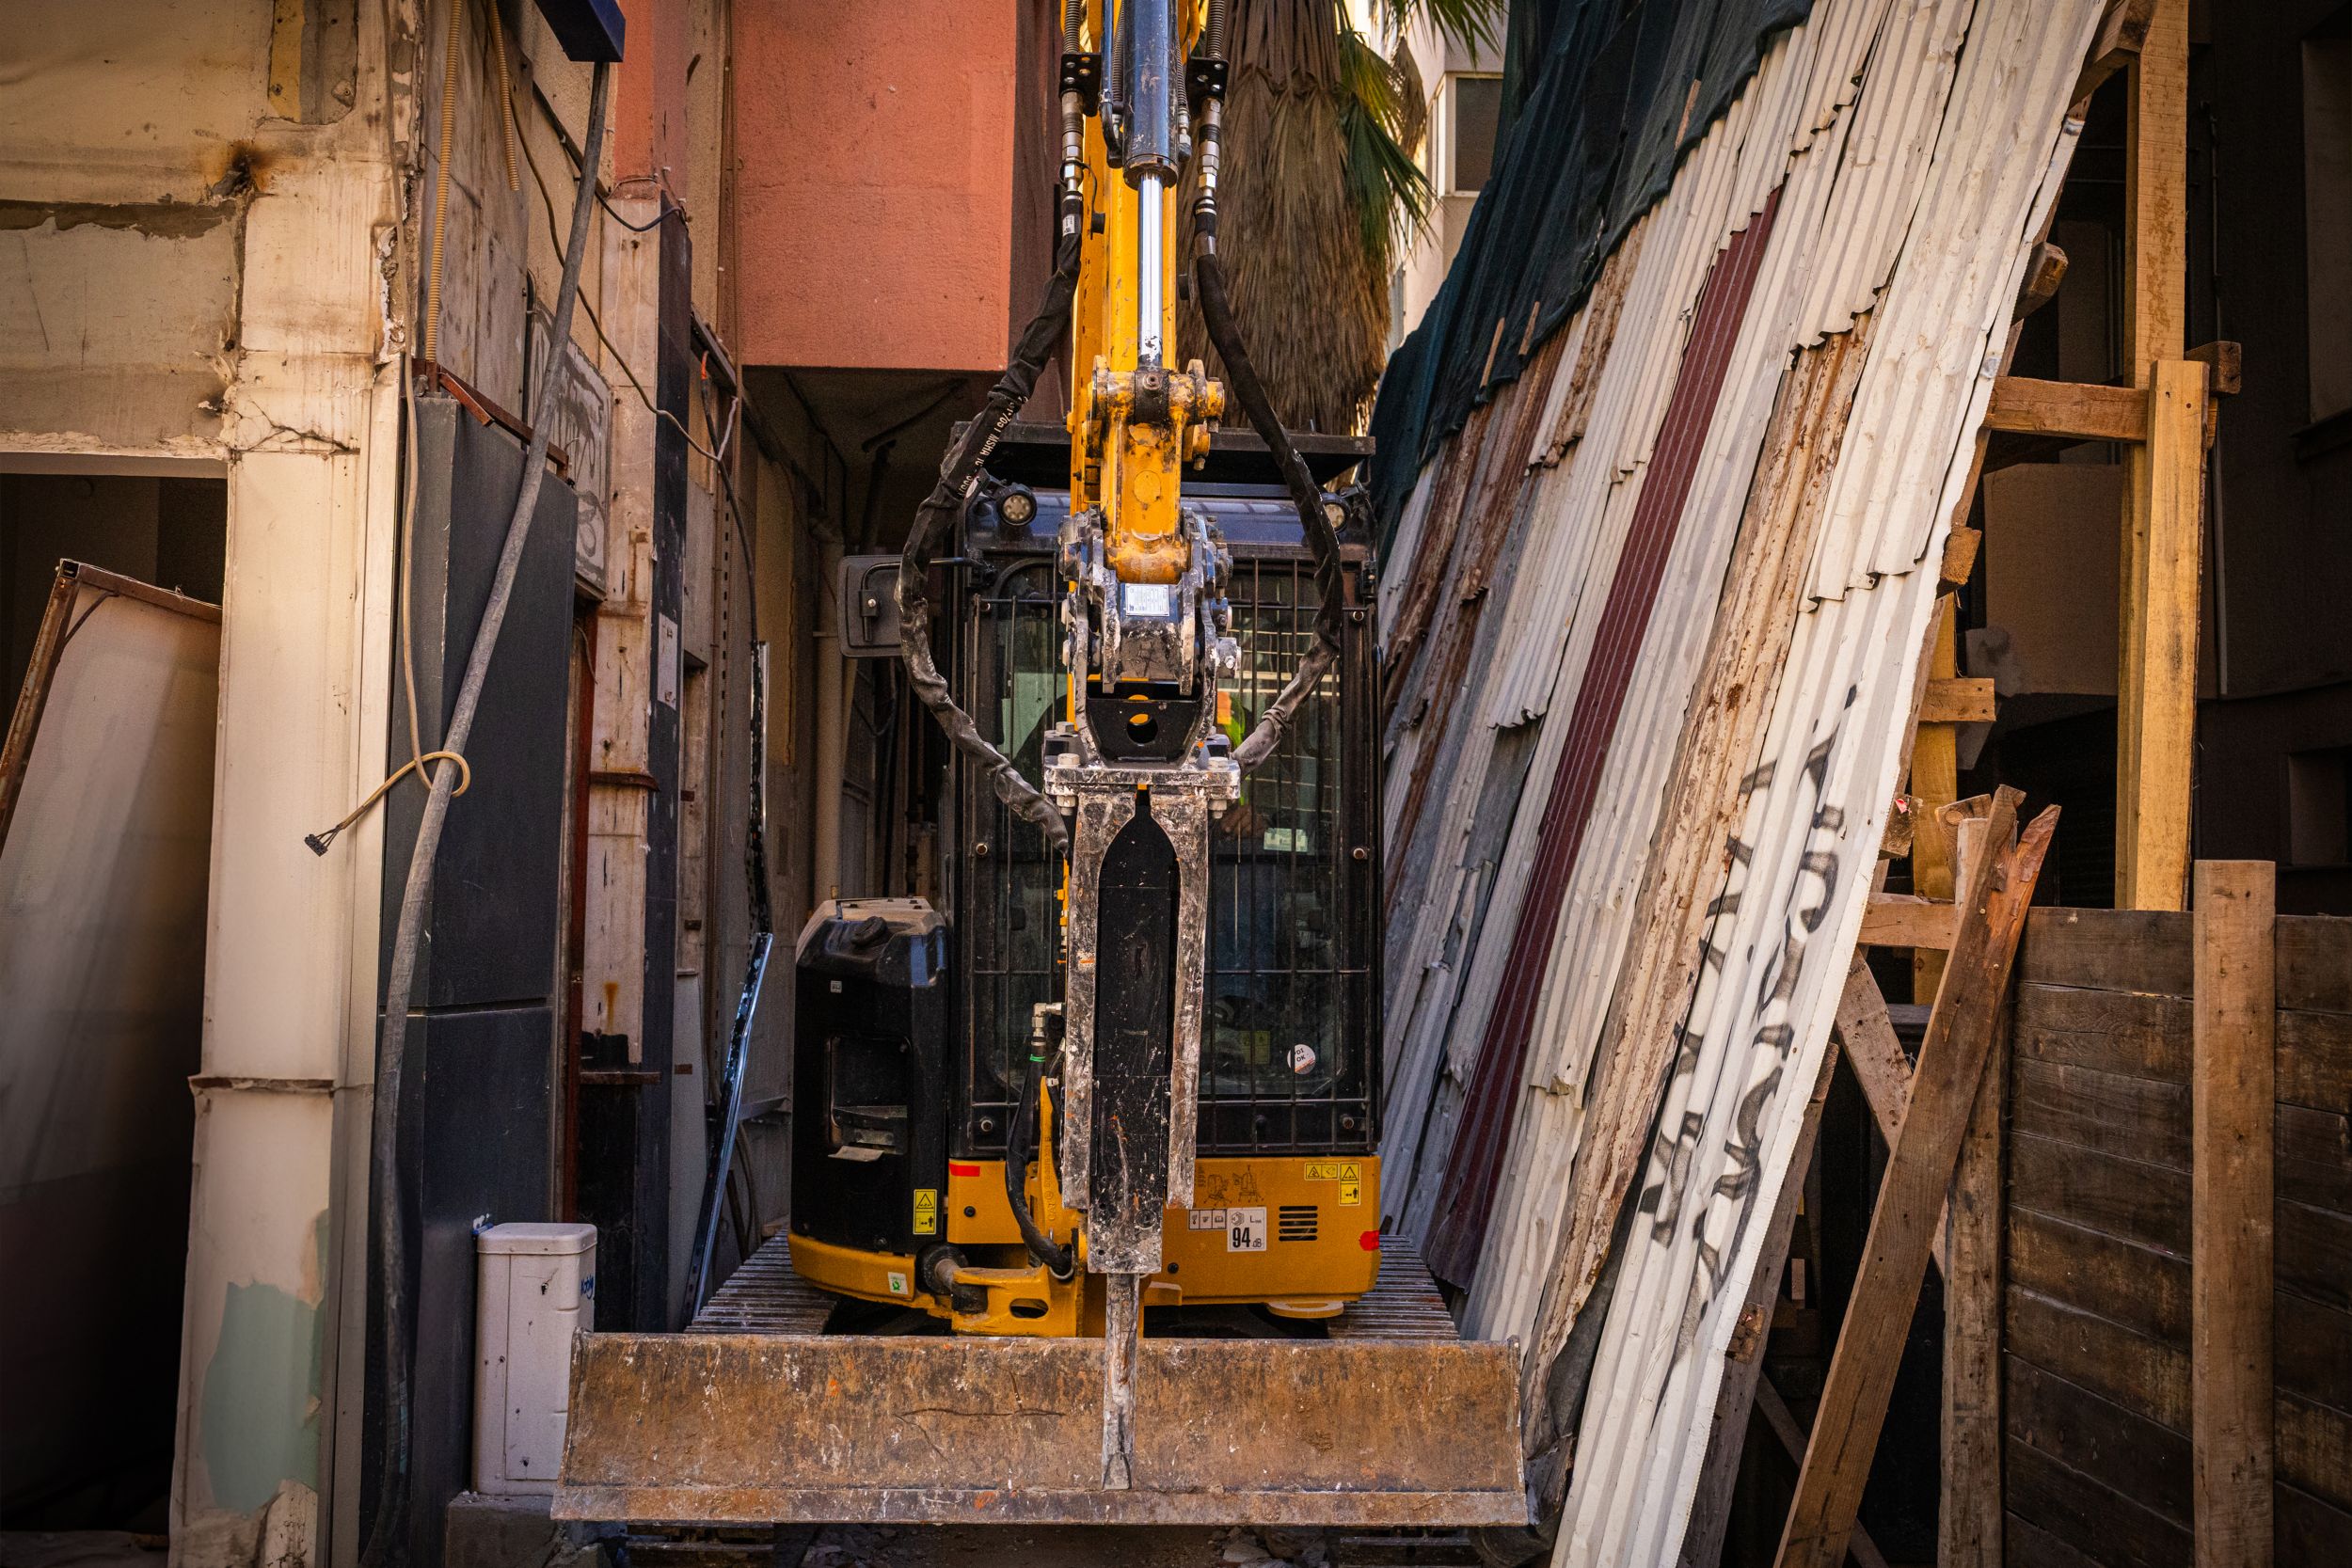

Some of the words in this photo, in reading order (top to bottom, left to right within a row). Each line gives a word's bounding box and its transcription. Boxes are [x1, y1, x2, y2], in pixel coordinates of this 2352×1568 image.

[979, 434, 1000, 456] MSHA
[1232, 1227, 1250, 1248] 94
[1252, 1238, 1262, 1248] dB
